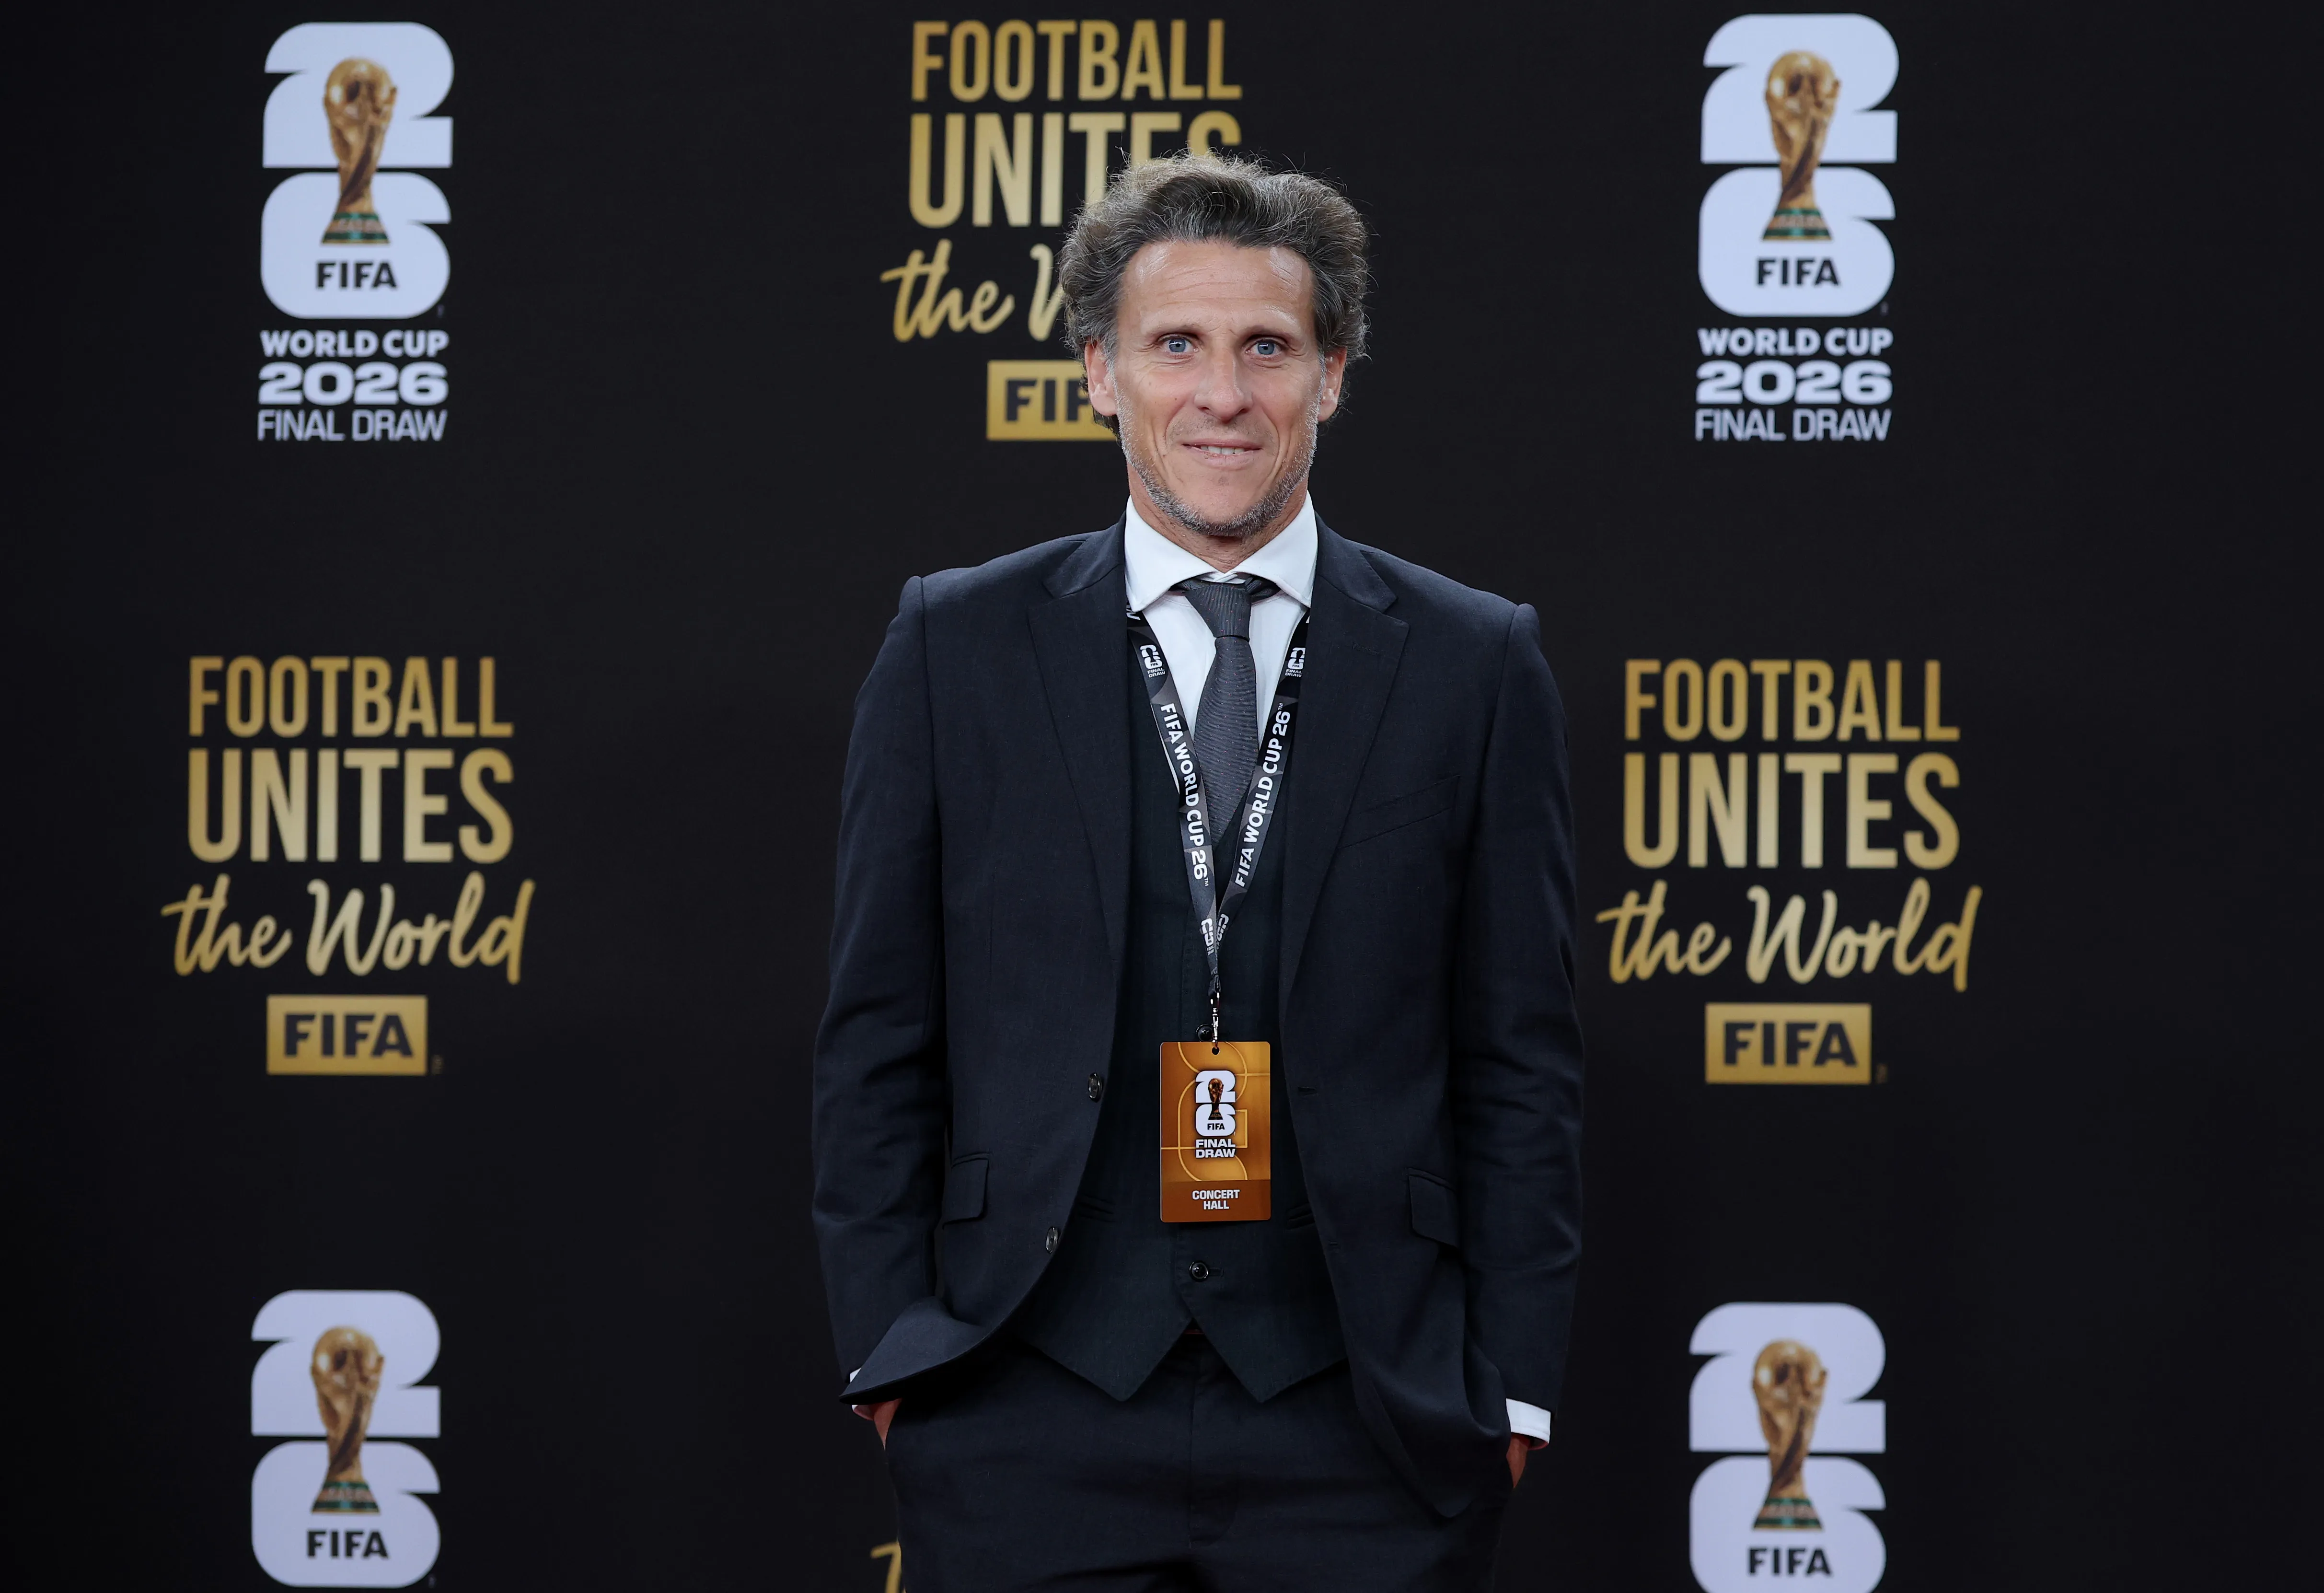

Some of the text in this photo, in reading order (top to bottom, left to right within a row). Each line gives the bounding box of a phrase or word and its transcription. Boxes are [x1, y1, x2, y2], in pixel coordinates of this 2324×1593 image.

[913, 20, 1241, 101] FOOTBALL
[317, 262, 396, 288] FIFA
[881, 240, 1014, 341] the
[1757, 259, 1838, 285] FIFA
[261, 330, 448, 357] WORLD CUP
[1699, 328, 1893, 355] WORLD CUP
[259, 362, 447, 405] 2026
[1006, 378, 1089, 422] FIF
[1697, 360, 1892, 404] 2026
[258, 410, 447, 441] FINAL DRAW
[1696, 409, 1891, 441] FINAL DRAW
[190, 657, 512, 736] FOOTBALL
[1626, 660, 1959, 741] FOOTBALL
[1160, 703, 1183, 744] FIFA
[1174, 742, 1199, 807] WORLD
[1187, 809, 1204, 847] CUP
[1262, 738, 1283, 774] CUP
[189, 749, 512, 862] UNITES
[1244, 776, 1273, 843] WORLD
[1625, 754, 1958, 868] UNITES
[1235, 848, 1255, 887] FIFA
[162, 872, 533, 983] the World
[1596, 879, 1981, 990] the World
[285, 1013, 413, 1057] FIFA
[1724, 1022, 1857, 1067] FIFA
[1196, 1139, 1236, 1148] FINAL
[1196, 1149, 1235, 1158] DRAW
[1192, 1189, 1240, 1200] CONCERT
[1203, 1200, 1229, 1210] HALL
[308, 1531, 388, 1558] FIFA
[1749, 1548, 1831, 1575] FIFA
